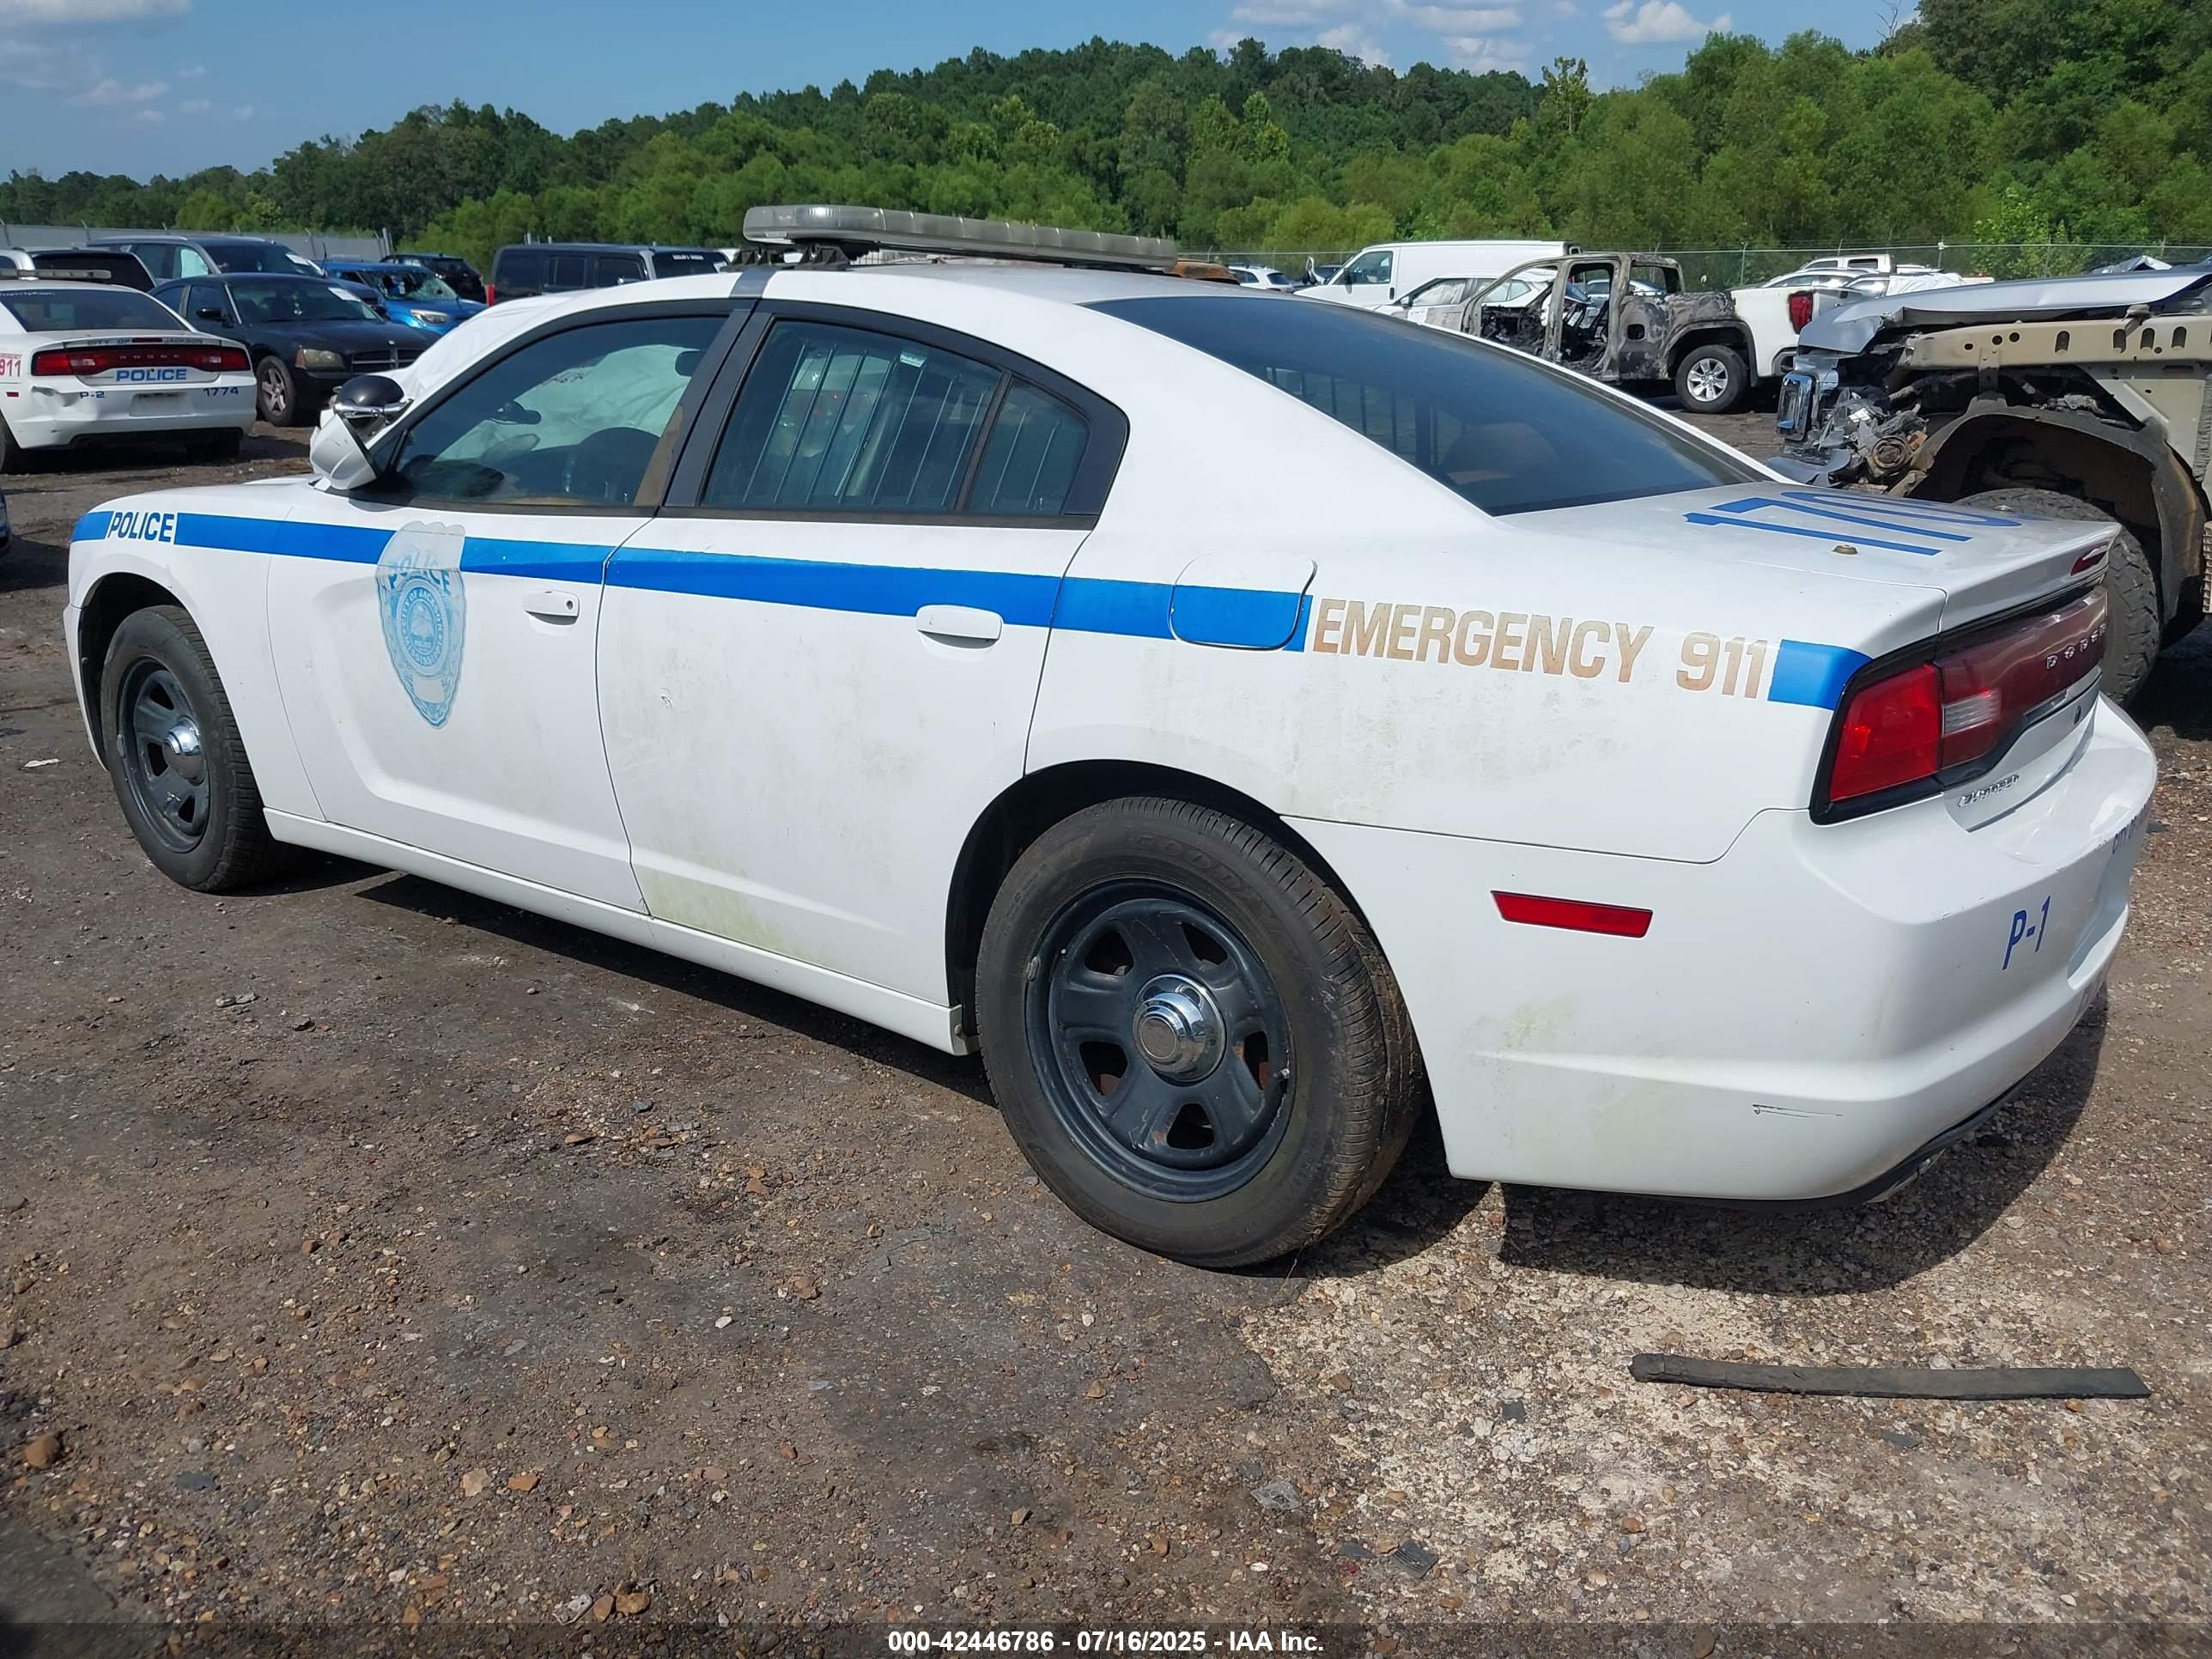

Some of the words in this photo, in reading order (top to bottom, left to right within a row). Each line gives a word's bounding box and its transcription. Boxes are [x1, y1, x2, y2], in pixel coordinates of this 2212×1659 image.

[116, 368, 187, 381] POLICE
[203, 386, 239, 398] 1774
[106, 511, 175, 544] POLICE
[388, 550, 452, 596] POLICE
[1313, 599, 1655, 684] EMERGENCY
[1675, 632, 1769, 700] 911
[2046, 623, 2106, 670] DODGE
[2002, 895, 2051, 970] P-1
